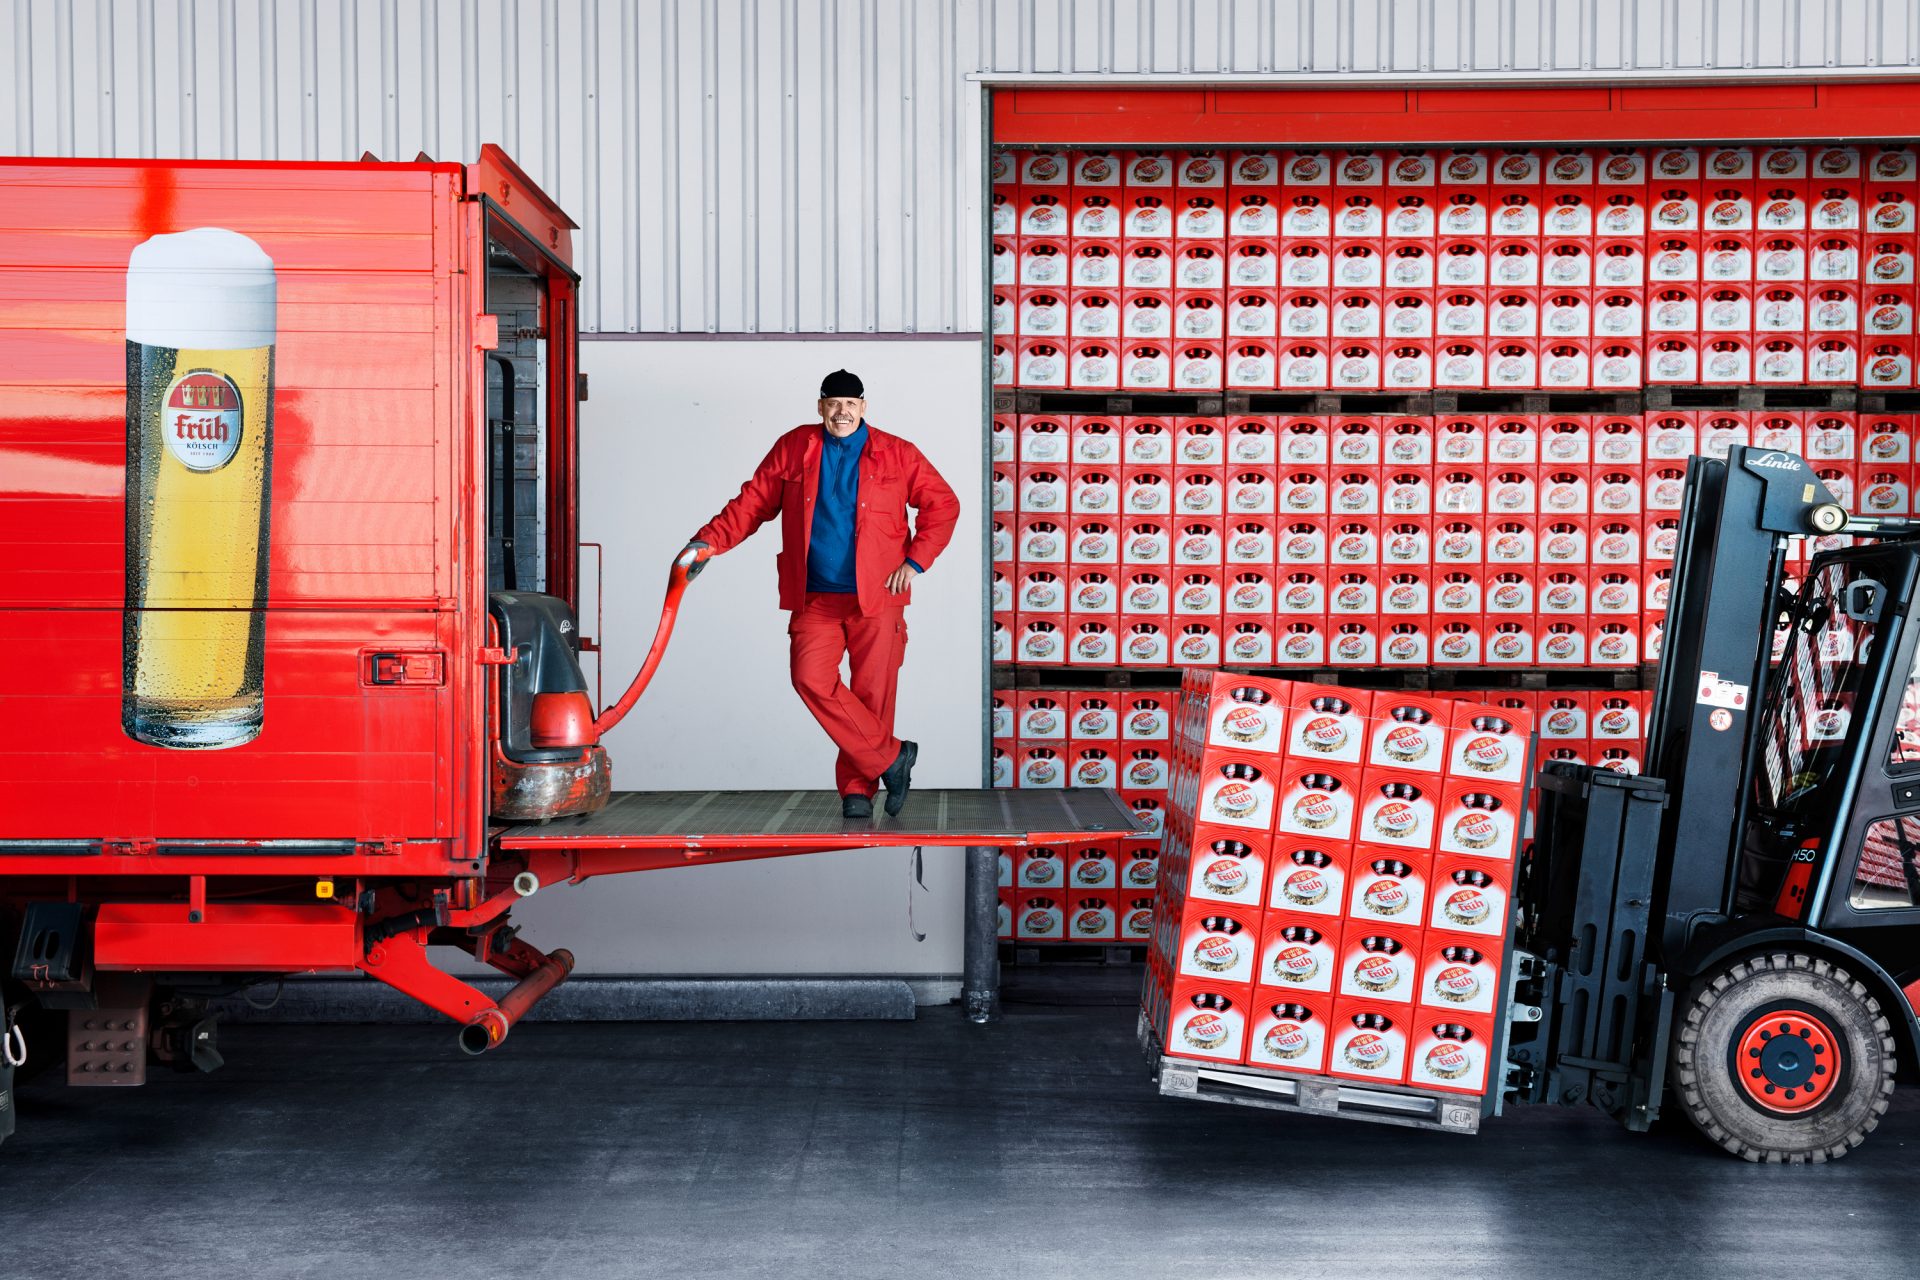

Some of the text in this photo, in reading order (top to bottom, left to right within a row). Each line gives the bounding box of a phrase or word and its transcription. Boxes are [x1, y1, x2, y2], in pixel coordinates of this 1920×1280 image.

[174, 414, 230, 443] früh
[186, 441, 218, 450] KÖLSCH
[1747, 452, 1801, 471] Linde
[1235, 717, 1262, 729] früh
[1315, 727, 1342, 739] früh
[1396, 736, 1423, 748] früh
[1476, 747, 1503, 759] früh
[1226, 793, 1253, 805] früh
[1305, 804, 1332, 816] früh
[1386, 813, 1413, 825] früh
[1466, 823, 1493, 835] früh
[1790, 849, 1816, 861] H50
[1216, 870, 1243, 882] früh
[1296, 880, 1323, 892] früh
[1376, 890, 1403, 902] früh
[1457, 900, 1484, 912] früh
[1206, 946, 1233, 958] früh
[1286, 957, 1313, 969] früh
[1366, 966, 1393, 978] früh
[1447, 977, 1474, 989] früh
[1196, 1024, 1223, 1036] früh
[1276, 1033, 1303, 1045] früh
[1357, 1044, 1384, 1056] früh
[1437, 1054, 1464, 1066] früh
